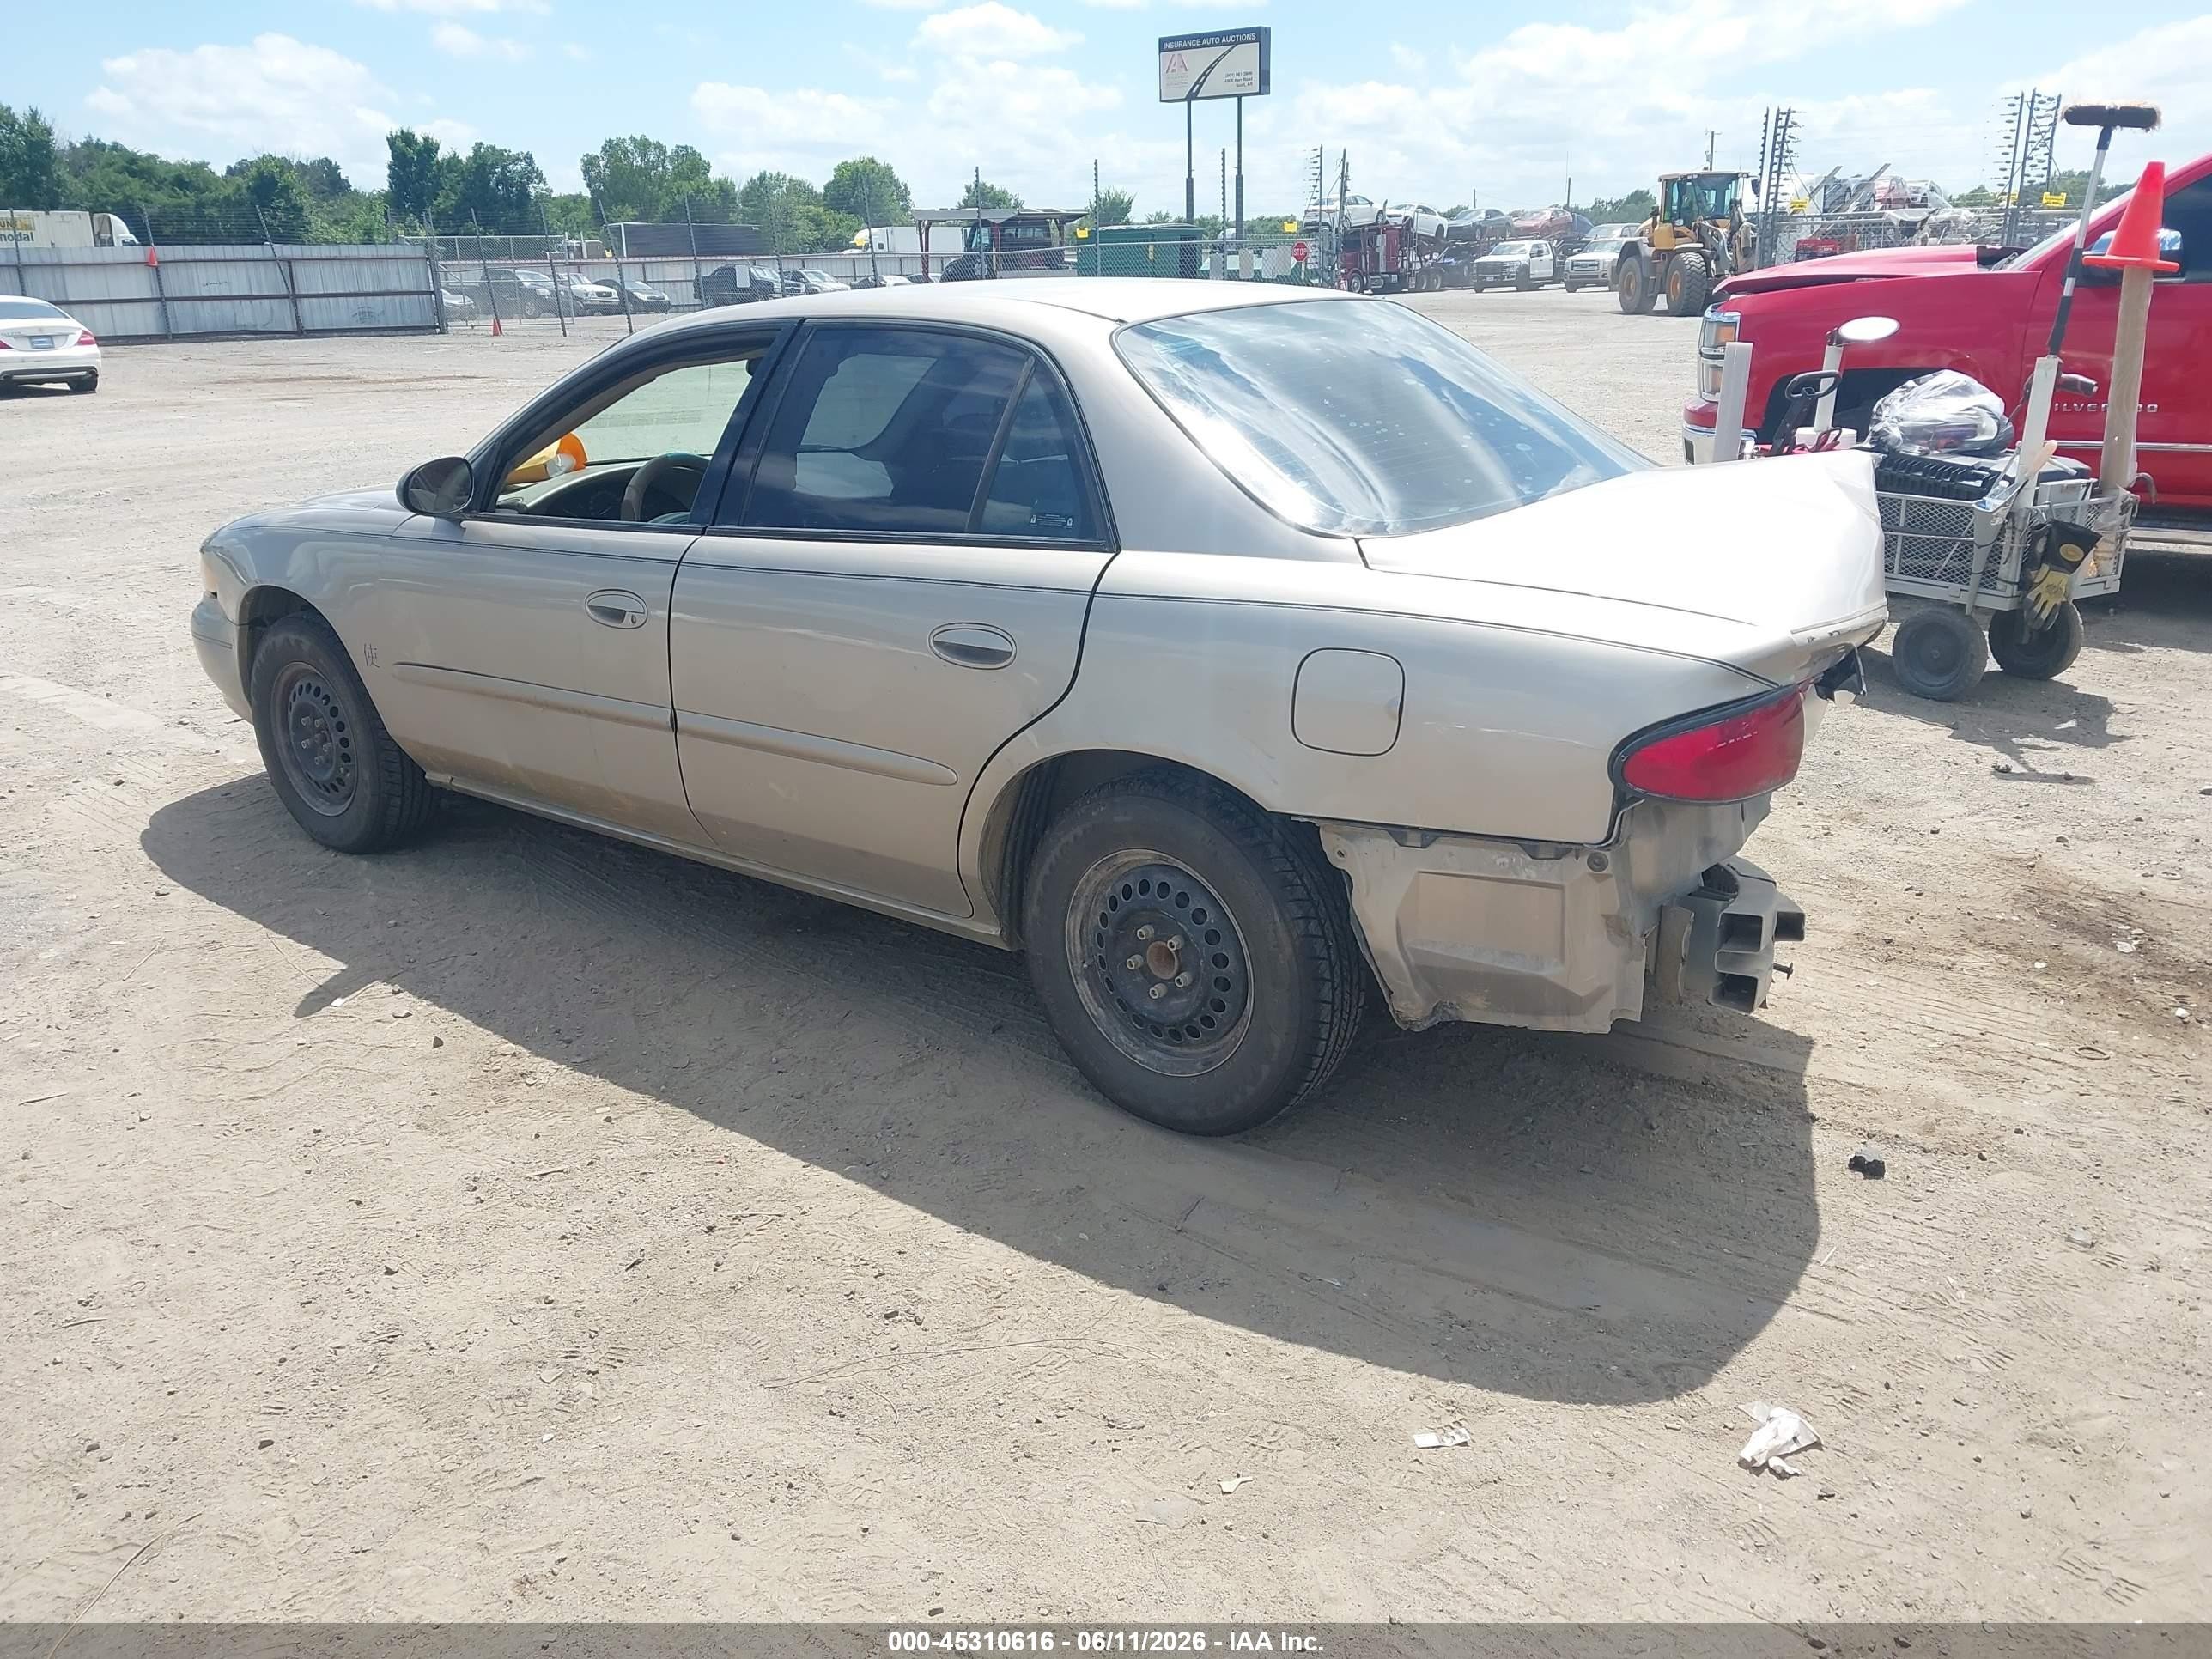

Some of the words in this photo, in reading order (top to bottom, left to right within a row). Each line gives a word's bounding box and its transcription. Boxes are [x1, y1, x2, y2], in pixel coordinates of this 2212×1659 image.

[1164, 39, 1202, 49] INSURANCE
[1221, 33, 1256, 43] AUCTIONS
[1294, 247, 1306, 256] STOP
